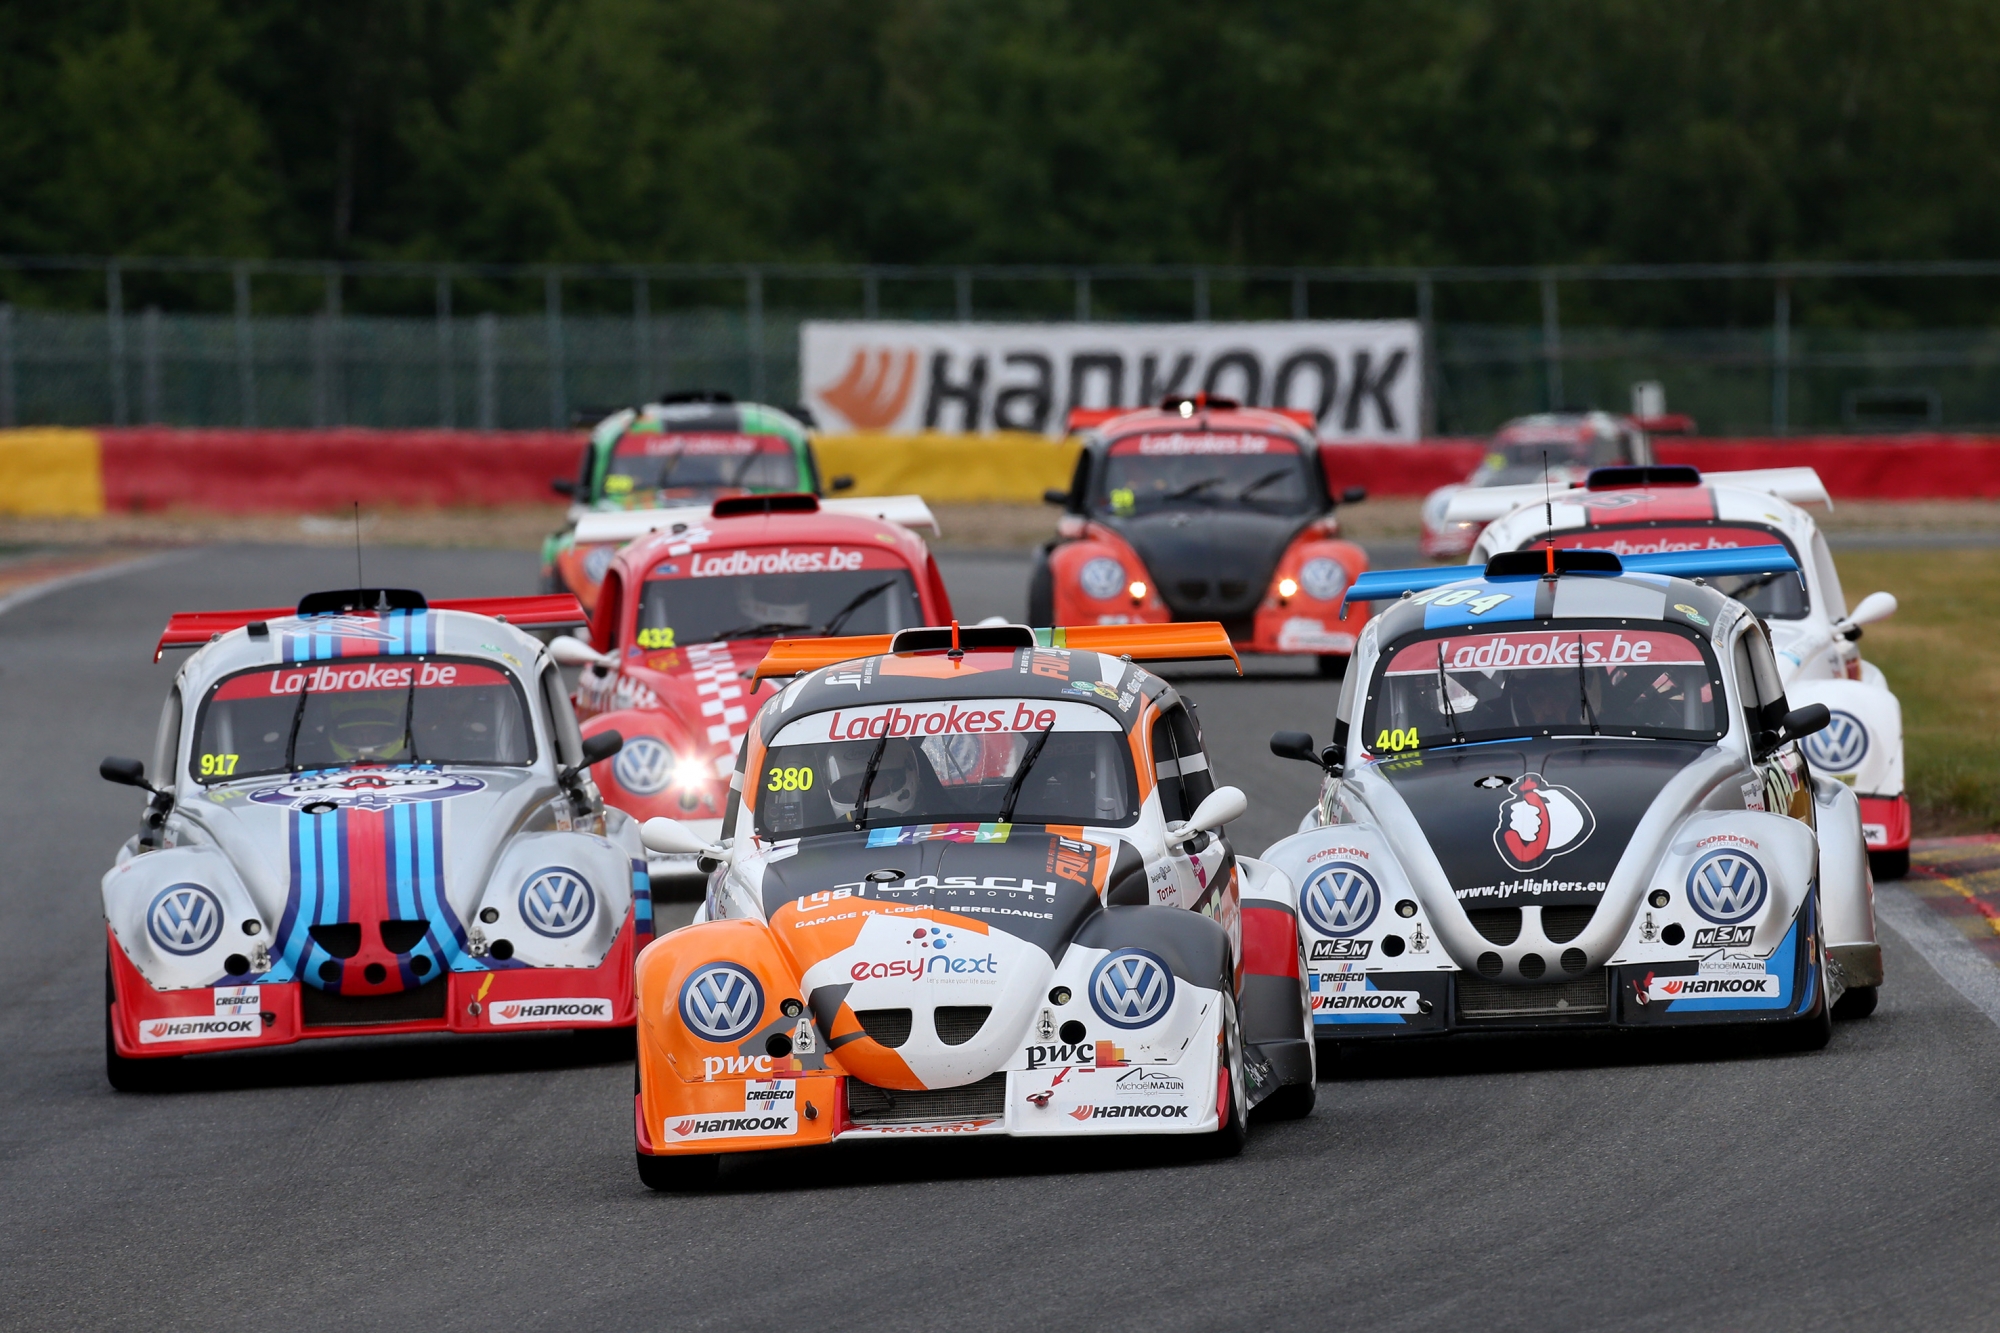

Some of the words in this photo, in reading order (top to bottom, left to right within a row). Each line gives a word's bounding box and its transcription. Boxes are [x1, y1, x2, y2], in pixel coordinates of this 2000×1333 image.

[690, 548, 863, 577] Ladbrokes.be
[637, 628, 674, 648] 432
[1436, 636, 1652, 668] Ladbrokes.be
[269, 663, 457, 694] Ladbrokes.be
[828, 702, 1056, 740] Ladbrokes.be
[1376, 728, 1420, 750] 404
[201, 753, 239, 775] 917
[767, 767, 813, 792] 380
[1696, 835, 1759, 849] GORDON
[1307, 847, 1370, 863] GORDON
[1456, 879, 1606, 899] www.jyl-lighters.eu
[795, 912, 857, 928] GARAGE
[885, 904, 934, 914] LOSCH
[950, 906, 1053, 920] BERELDANGE
[1320, 973, 1364, 982] CREDECO
[215, 996, 258, 1006] CREDECO
[1025, 1044, 1094, 1070] pwc
[703, 1055, 772, 1082] pwc
[746, 1091, 794, 1101] CREDECO
[1149, 1082, 1184, 1090] MAZUIN
